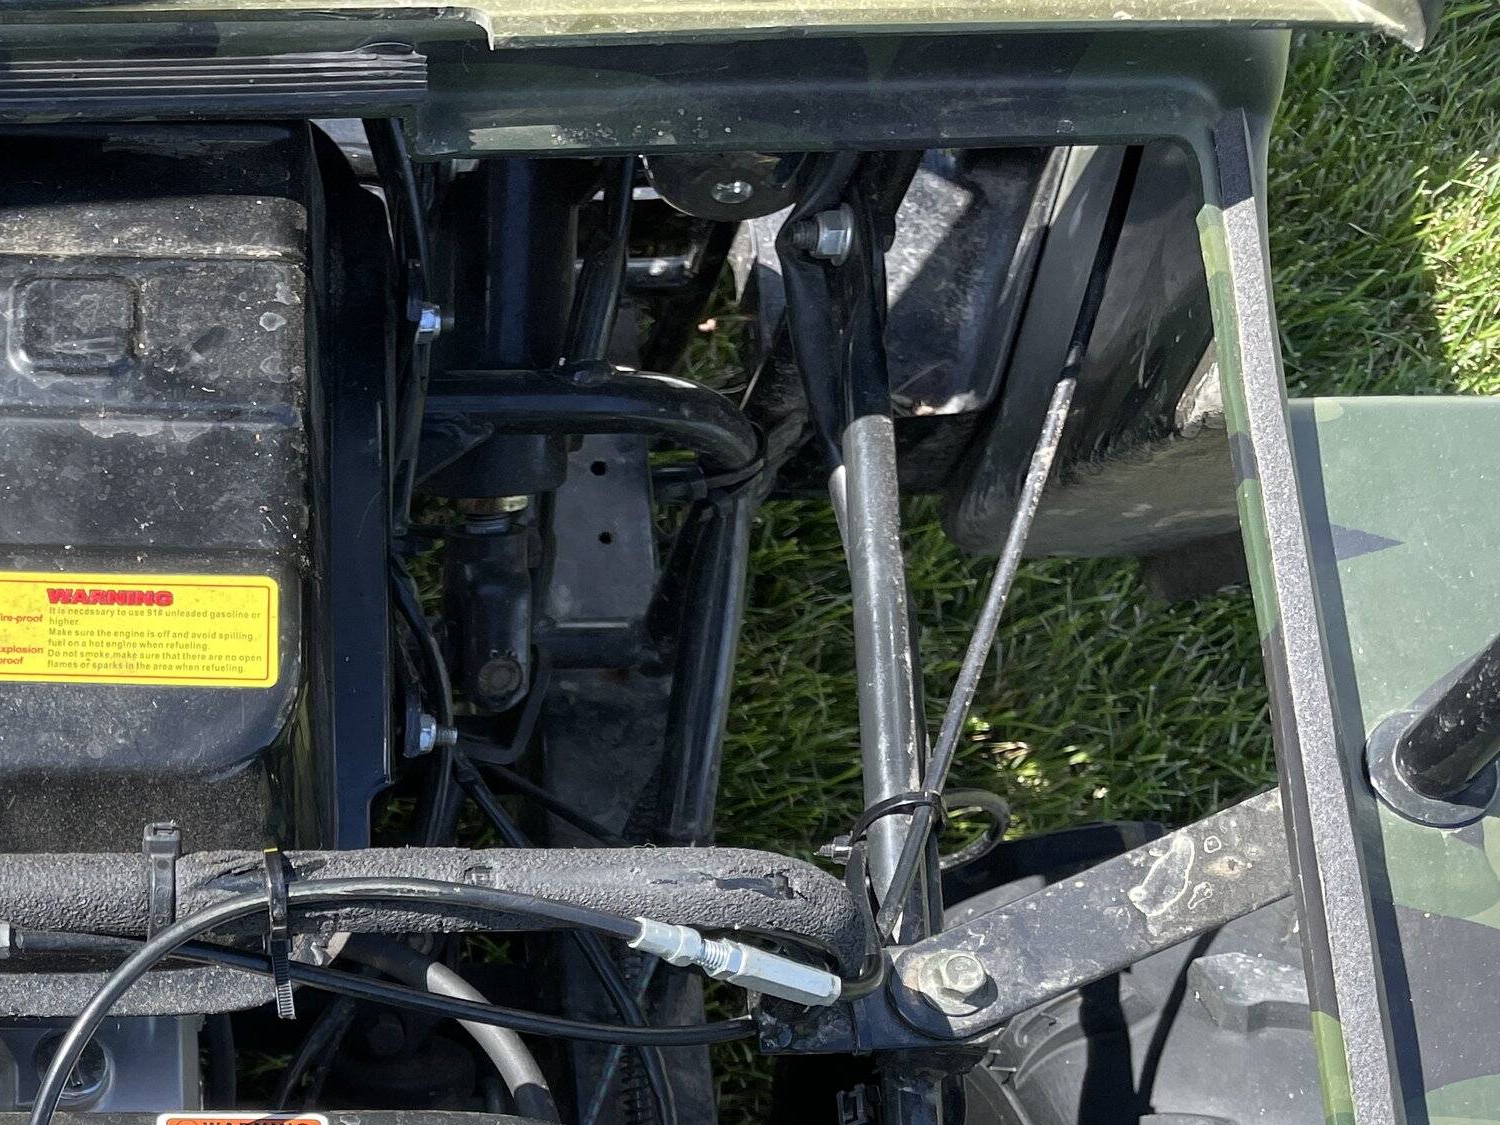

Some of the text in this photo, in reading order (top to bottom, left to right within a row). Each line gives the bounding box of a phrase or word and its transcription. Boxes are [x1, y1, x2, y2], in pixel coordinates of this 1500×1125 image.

[47, 588, 173, 606] WARNING
[68, 608, 115, 617] necessary
[147, 609, 162, 617] 91#
[165, 609, 207, 618] unleaded
[209, 610, 249, 619] gasoline
[49, 628, 72, 636] Make
[97, 629, 112, 637] the
[113, 630, 144, 639] engine
[147, 630, 155, 638] is
[157, 630, 170, 638] off
[172, 631, 189, 639] and
[191, 631, 217, 640] avoid
[47, 639, 65, 647] fuel
[89, 640, 104, 648] hot
[106, 641, 137, 650] engine
[139, 641, 164, 649] when
[166, 642, 210, 651] refueling.
[63, 650, 77, 658] not
[162, 652, 180, 660] that
[182, 653, 207, 661] there
[238, 655, 262, 663] open
[47, 660, 78, 669] flames
[92, 661, 123, 671] sparks
[125, 662, 134, 670] in
[136, 661, 151, 671] the
[153, 663, 173, 671] area
[175, 662, 200, 671] when
